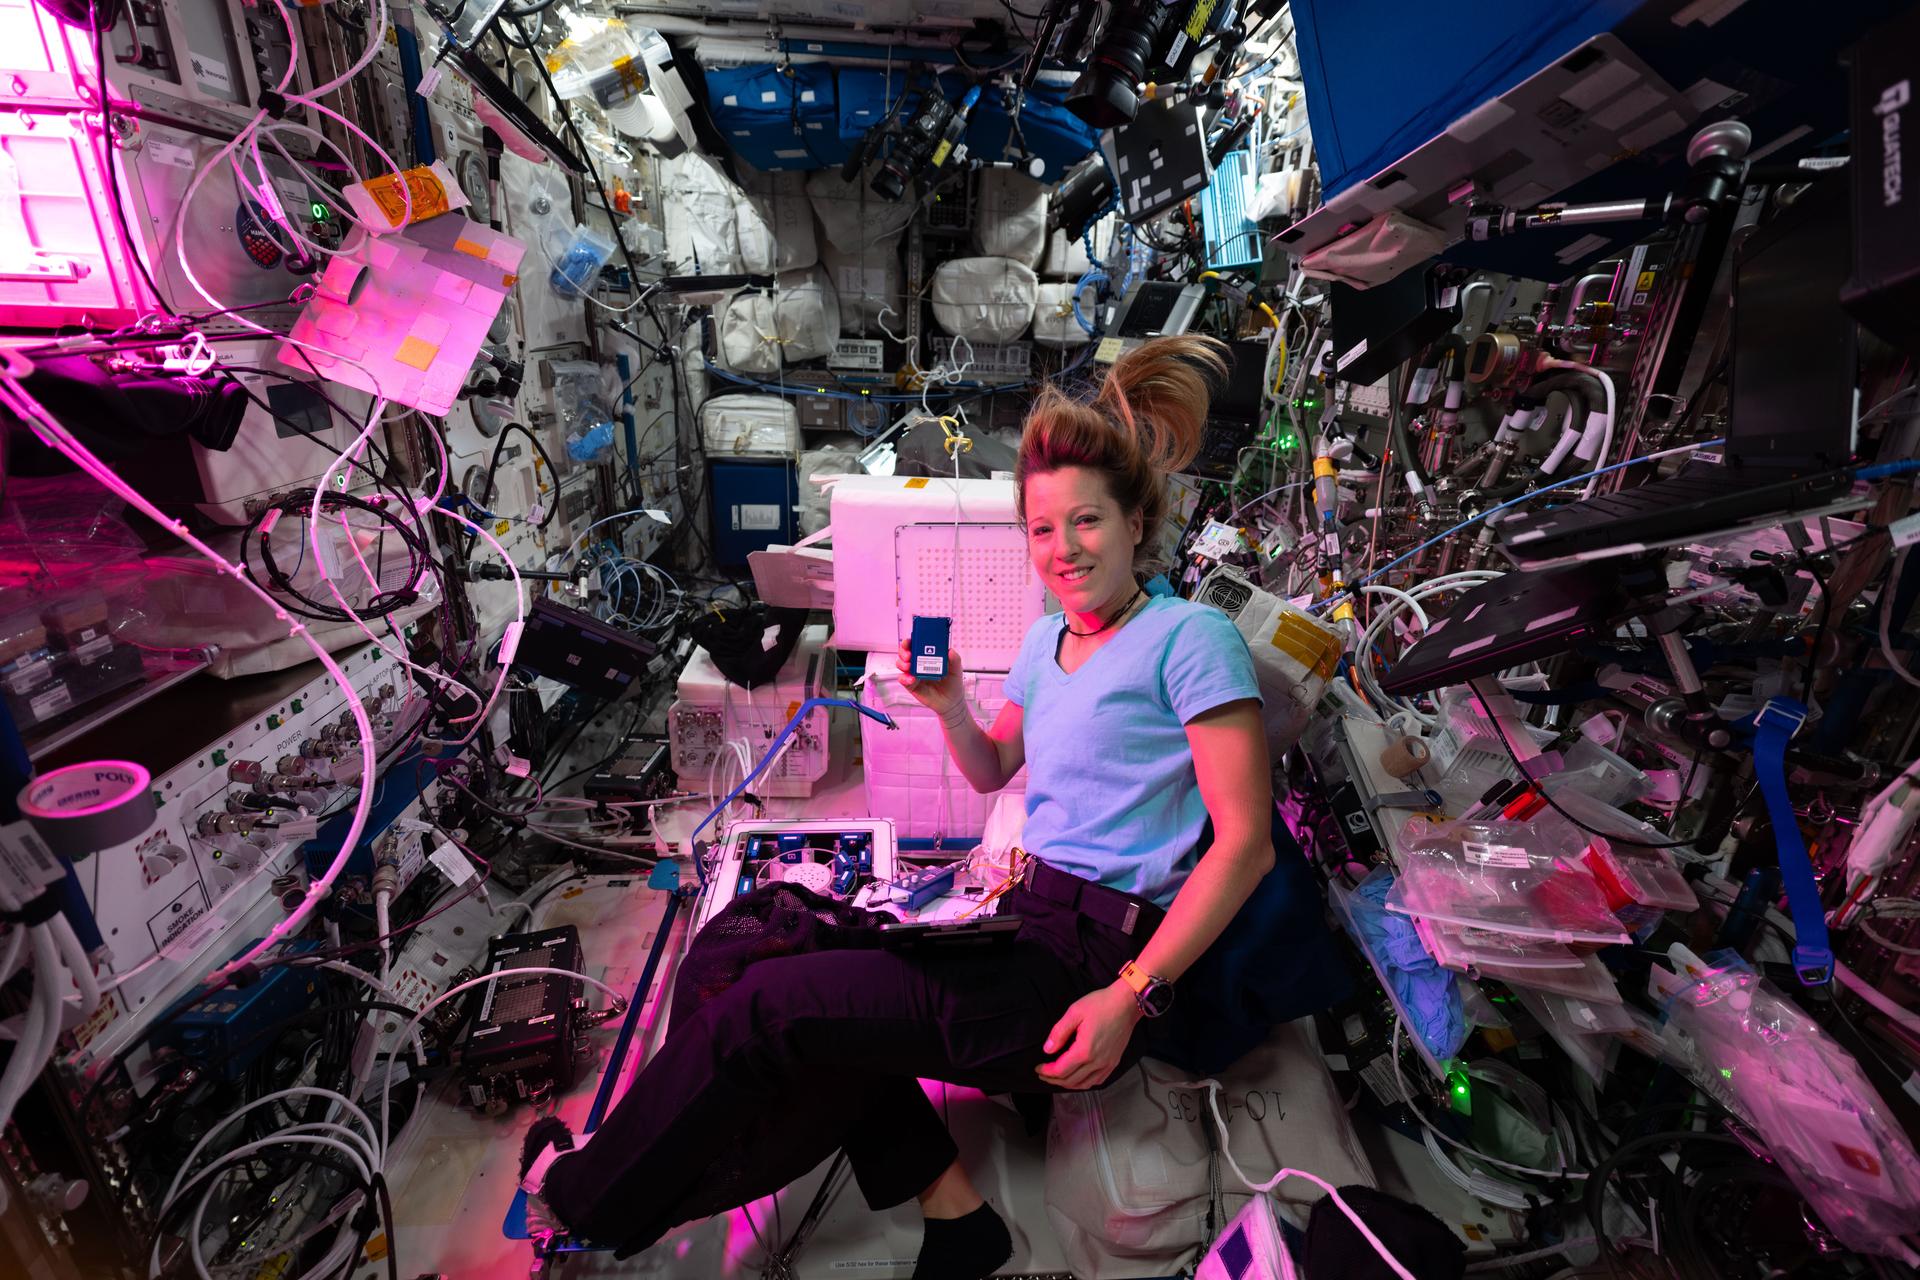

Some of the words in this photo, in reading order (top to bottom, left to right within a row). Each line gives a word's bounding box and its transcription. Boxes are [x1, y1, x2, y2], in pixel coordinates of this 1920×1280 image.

[1882, 111, 1902, 207] QUATECH
[369, 667, 389, 687] LAPTOP
[276, 730, 303, 753] POWER
[161, 907, 205, 948] INDICATION
[166, 906, 195, 933] SMOKE
